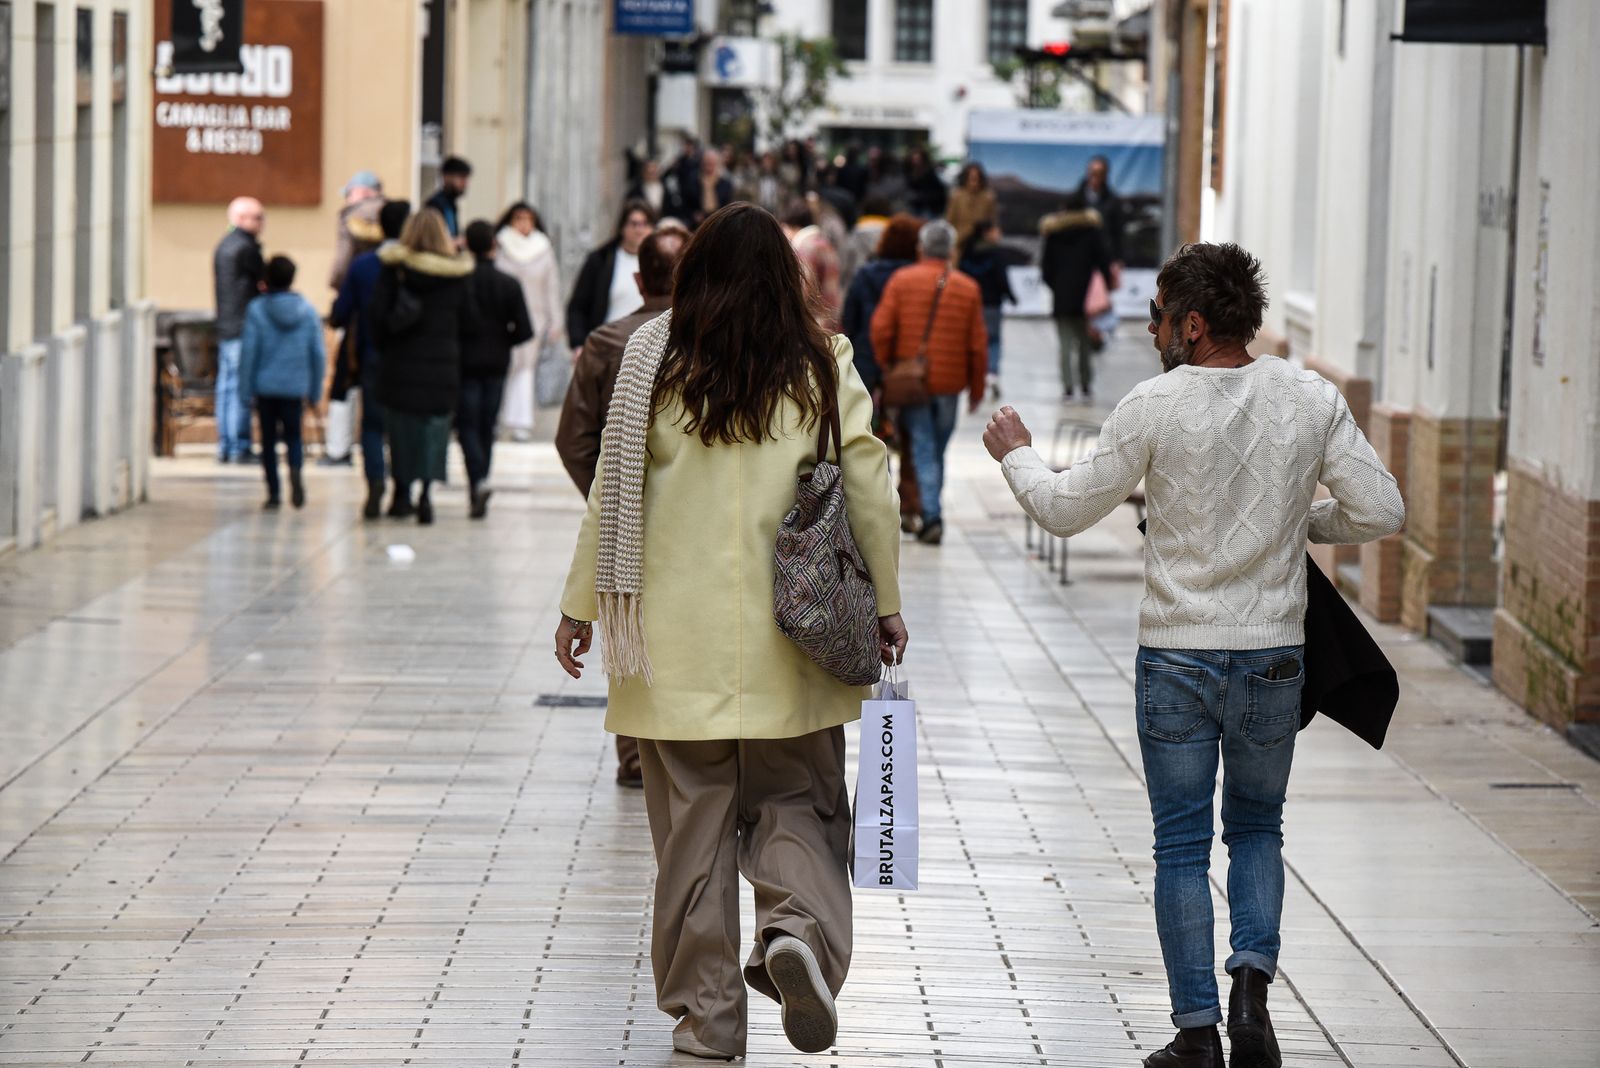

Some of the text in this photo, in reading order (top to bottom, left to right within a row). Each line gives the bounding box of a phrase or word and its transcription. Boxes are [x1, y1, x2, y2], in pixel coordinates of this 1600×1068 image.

[156, 103, 290, 130] CANAGLIA BAR
[185, 128, 262, 154] & RESTO
[879, 713, 893, 886] BRUTALZAPAS.COM
